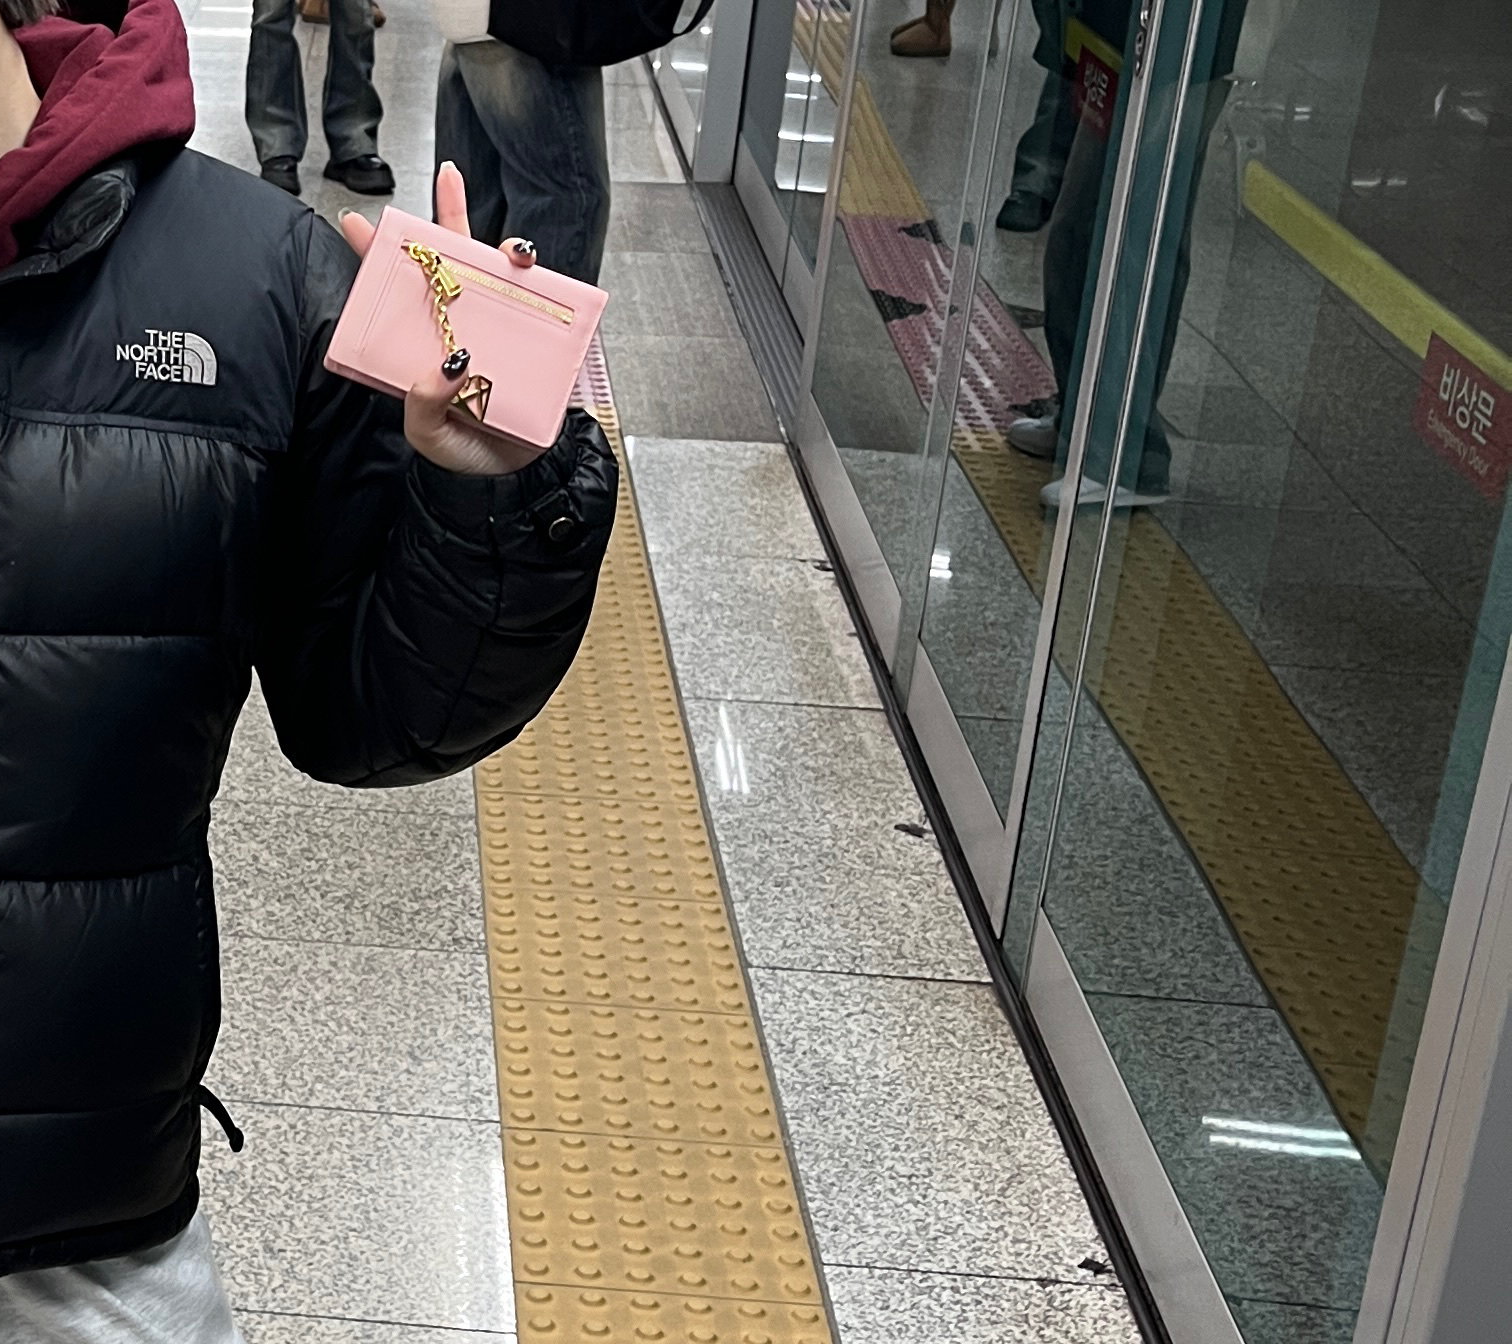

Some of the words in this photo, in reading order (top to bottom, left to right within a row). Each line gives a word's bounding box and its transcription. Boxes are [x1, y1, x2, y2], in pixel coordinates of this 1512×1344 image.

[145, 329, 184, 348] THE
[116, 344, 183, 365] NORTH
[135, 362, 182, 382] FACE
[1440, 363, 1495, 445] 비상문
